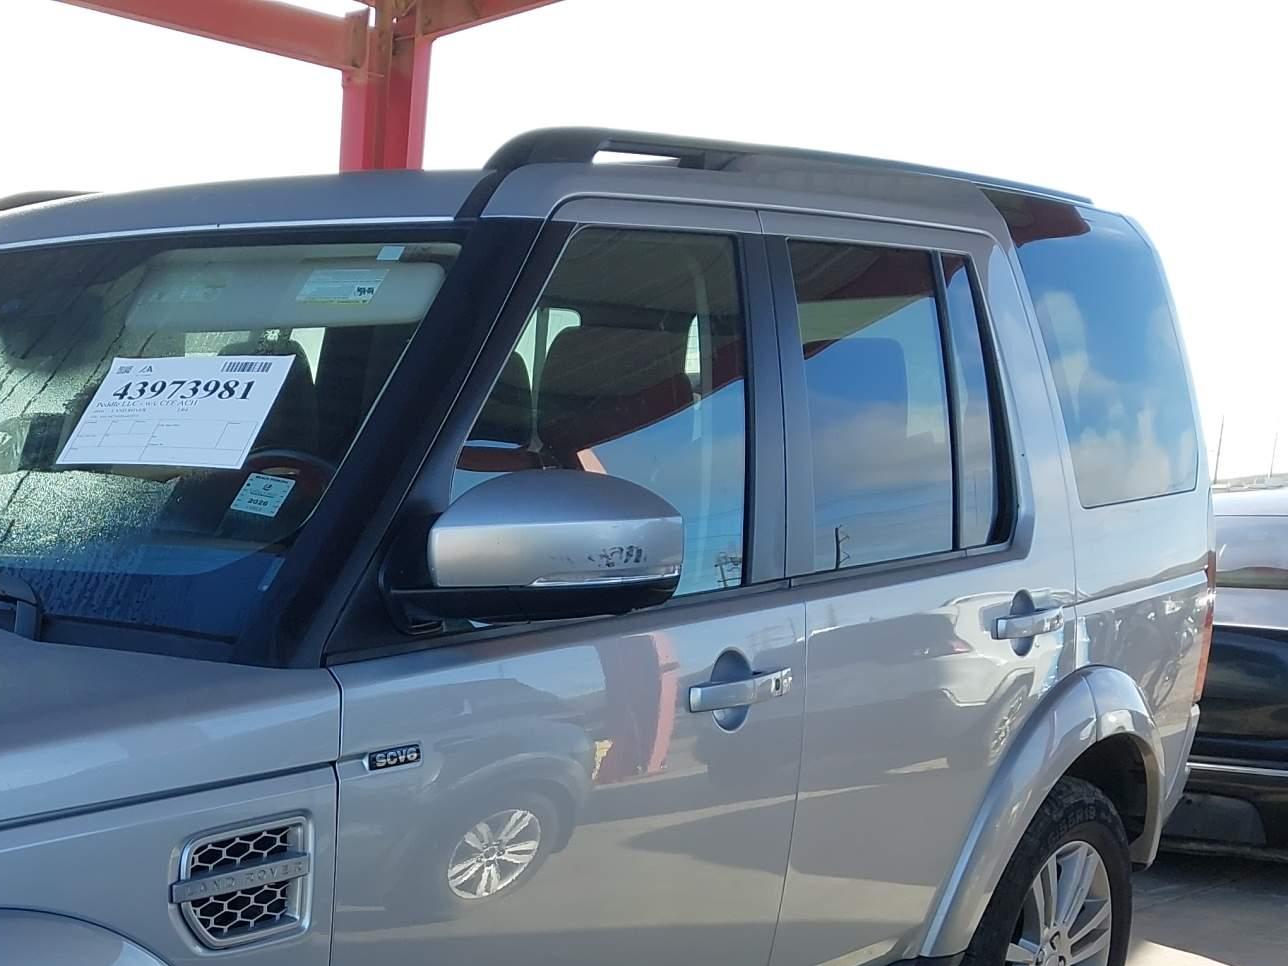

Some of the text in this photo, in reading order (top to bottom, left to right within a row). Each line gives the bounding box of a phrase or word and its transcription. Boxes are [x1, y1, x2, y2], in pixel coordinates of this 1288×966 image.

[112, 379, 256, 400] 43973981
[376, 747, 418, 767] SCV6
[184, 861, 304, 897] LAND ROVER
